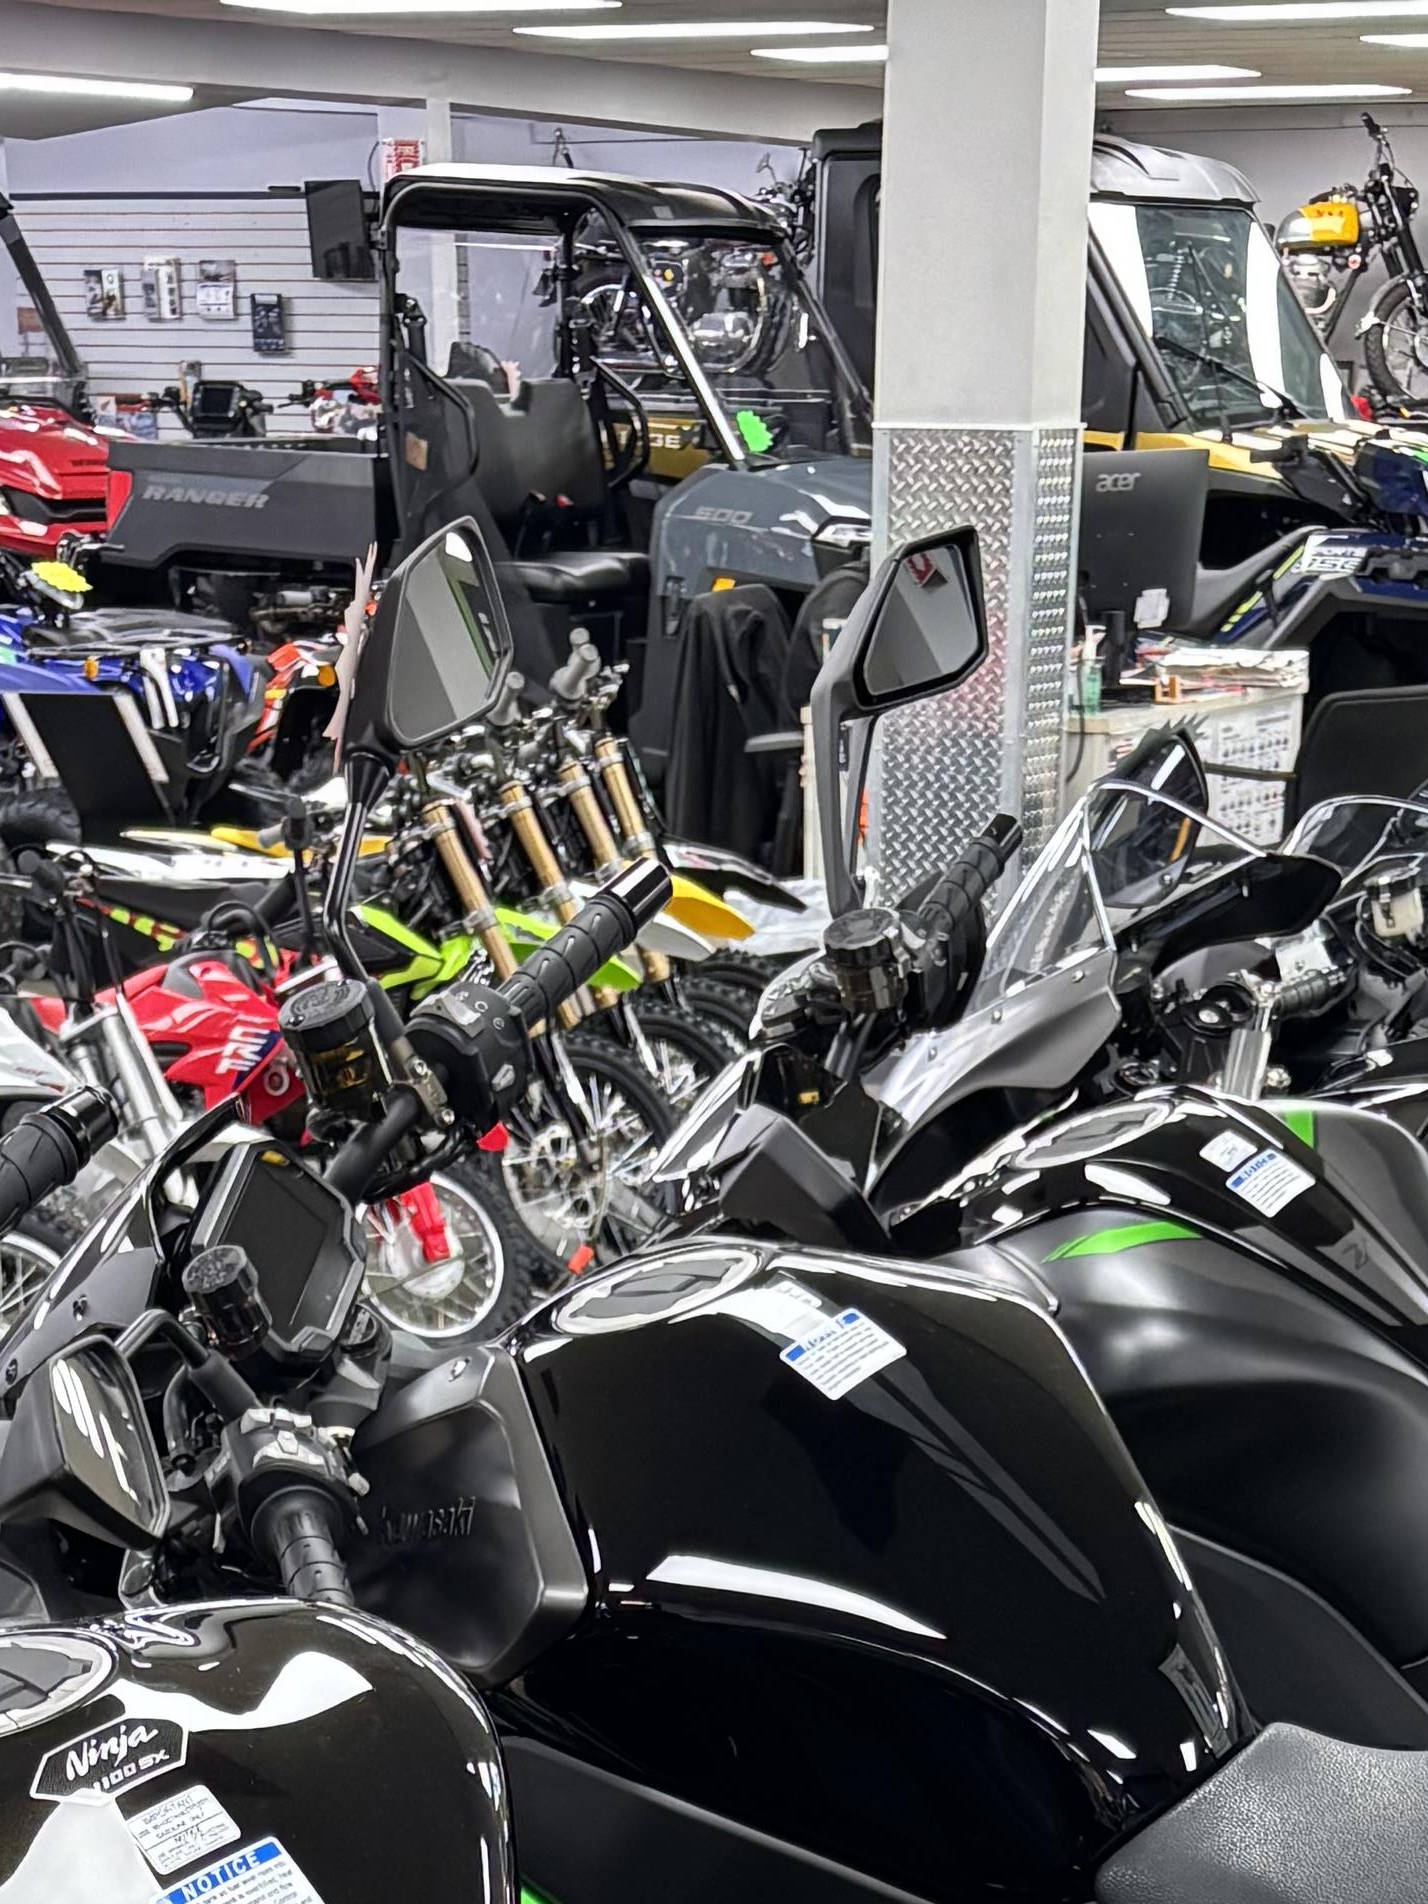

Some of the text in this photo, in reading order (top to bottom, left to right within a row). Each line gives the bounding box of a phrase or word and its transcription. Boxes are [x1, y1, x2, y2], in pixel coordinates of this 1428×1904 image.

[142, 485, 271, 509] RANGER
[1096, 472, 1142, 492] acer
[65, 1724, 159, 1781] Ninja
[180, 1851, 261, 1902] NOTICE
